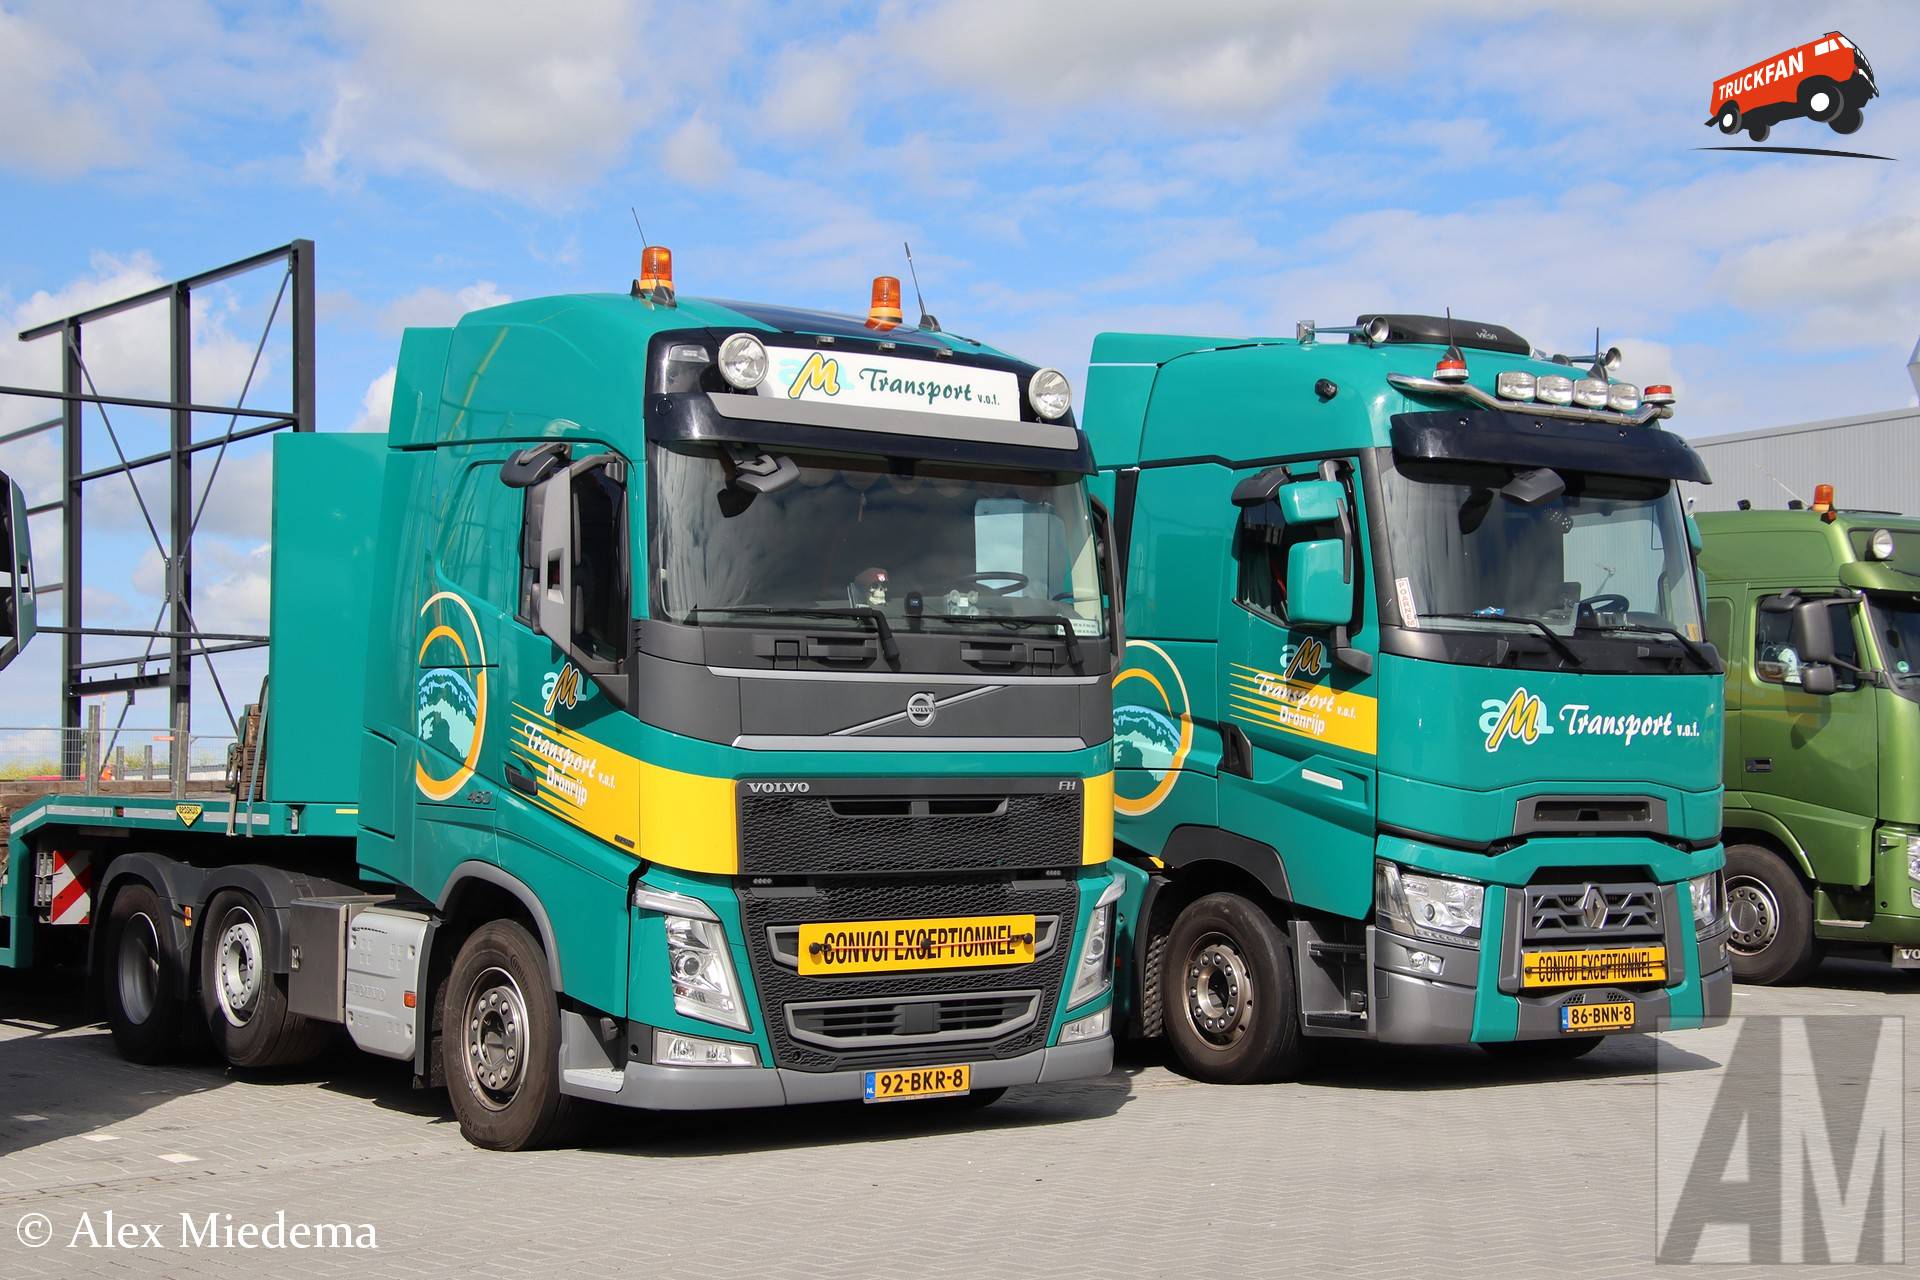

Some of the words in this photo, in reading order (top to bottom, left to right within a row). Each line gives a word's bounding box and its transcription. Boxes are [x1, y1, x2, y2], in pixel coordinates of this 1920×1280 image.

[858, 367, 972, 405] Transport
[1254, 673, 1335, 712] Transport
[1279, 705, 1325, 736] Dronrijp
[1559, 704, 1672, 746] Transport
[1676, 721, 1701, 737] v.o.f.
[524, 722, 598, 778] Transport
[546, 765, 588, 806] Dronrijp
[747, 782, 810, 794] VOLVO
[1058, 780, 1076, 791] FH
[823, 931, 889, 964] CONVOI
[894, 925, 1016, 961] EXCEPTIONNEL
[1538, 956, 1578, 983] CONVOI
[1581, 951, 1653, 980] EXCEPTIONNEL
[1571, 1005, 1632, 1025] 86-BNN-8
[880, 1069, 963, 1094] 92-BKR-8
